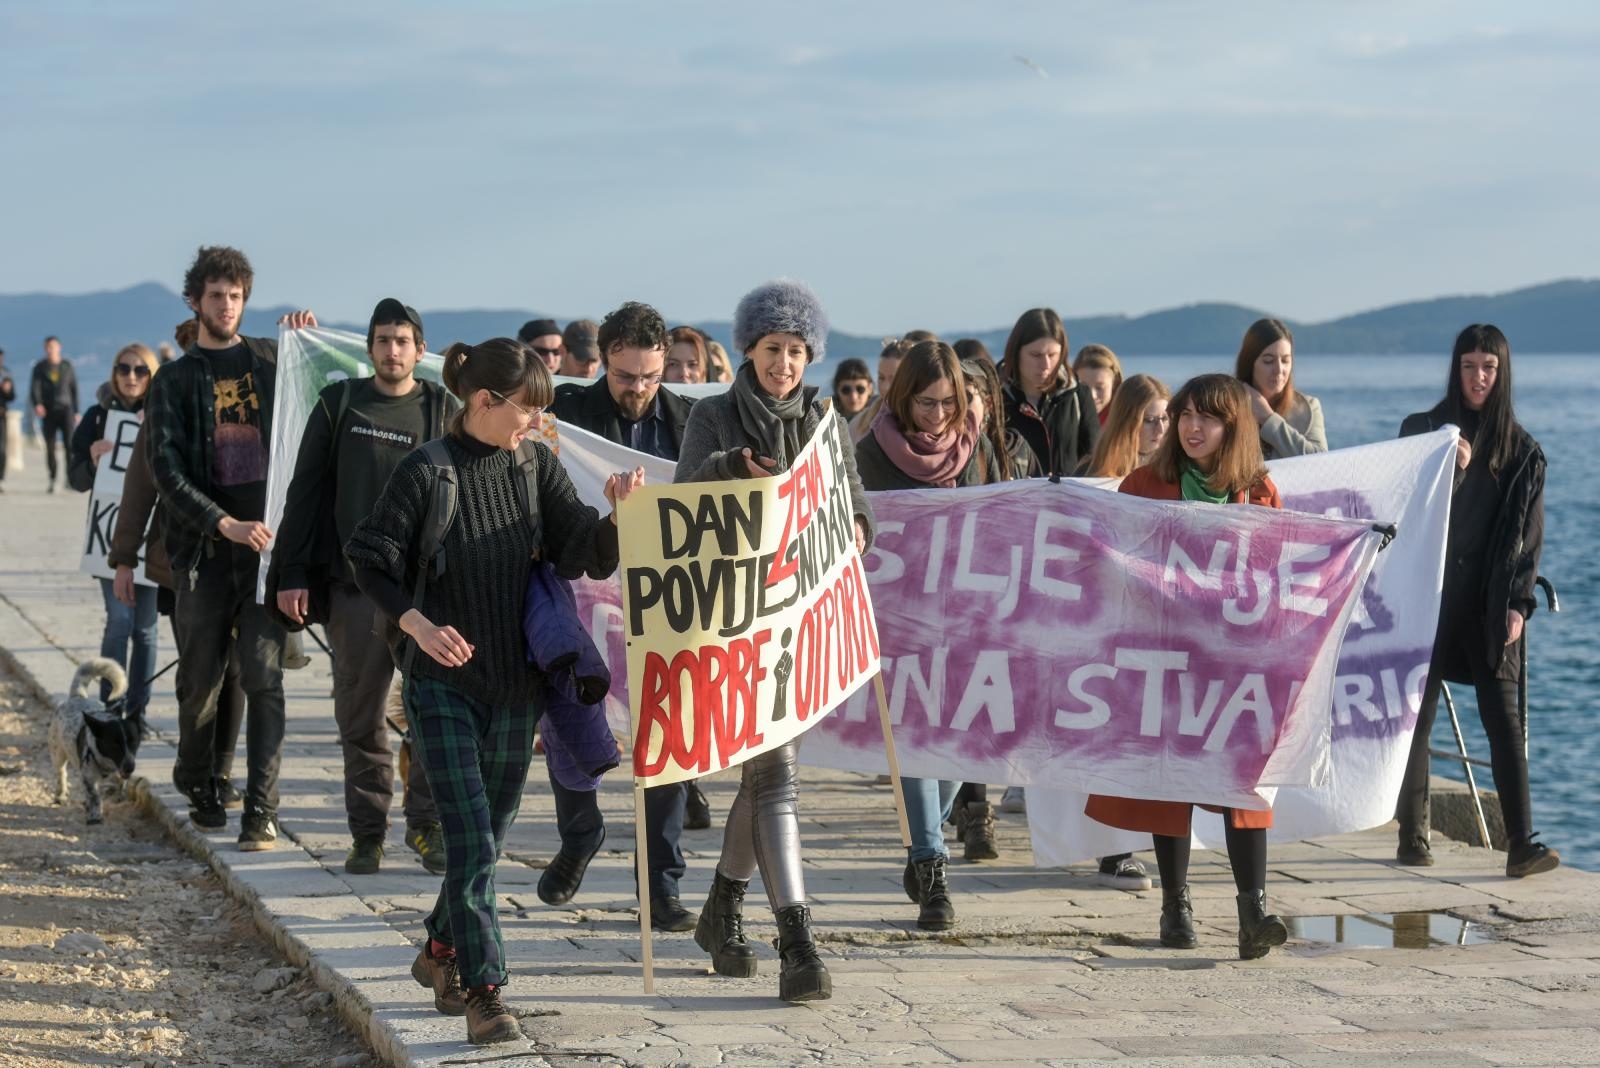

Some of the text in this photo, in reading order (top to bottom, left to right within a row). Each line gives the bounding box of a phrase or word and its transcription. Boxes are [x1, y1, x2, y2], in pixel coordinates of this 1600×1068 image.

[627, 520, 819, 637] POVIJESNI
[817, 482, 853, 576] DAN
[657, 490, 763, 559] DAN
[822, 413, 846, 496] JE
[633, 629, 772, 777] BORBE
[794, 555, 879, 722] OTPORA
[1054, 648, 1304, 754] STVA
